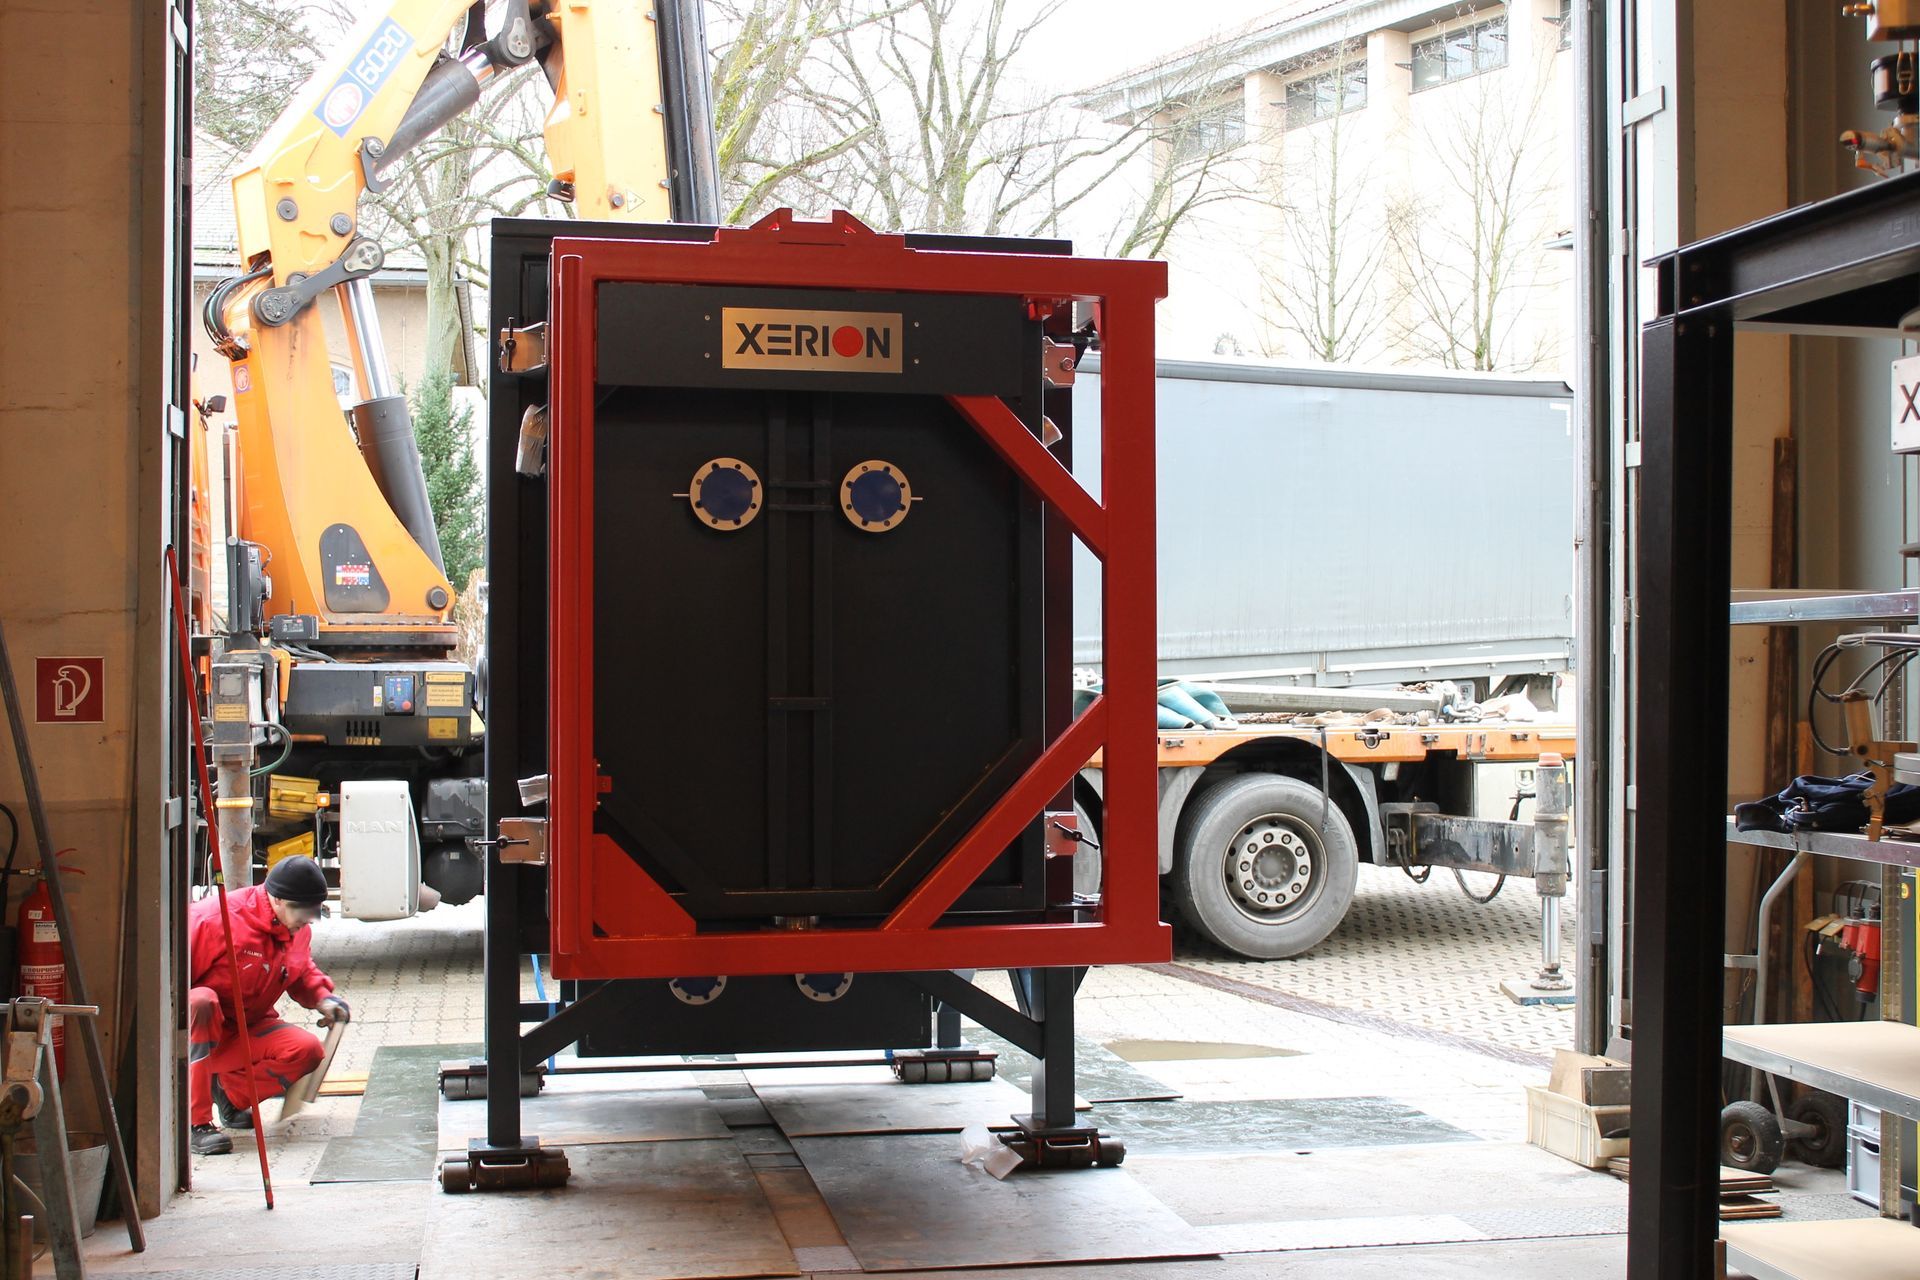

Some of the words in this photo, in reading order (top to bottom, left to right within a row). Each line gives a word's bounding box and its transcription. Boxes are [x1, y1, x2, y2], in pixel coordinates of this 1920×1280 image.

[355, 24, 407, 85] 6020
[735, 323, 890, 359] XERION
[347, 820, 404, 833] MAN
